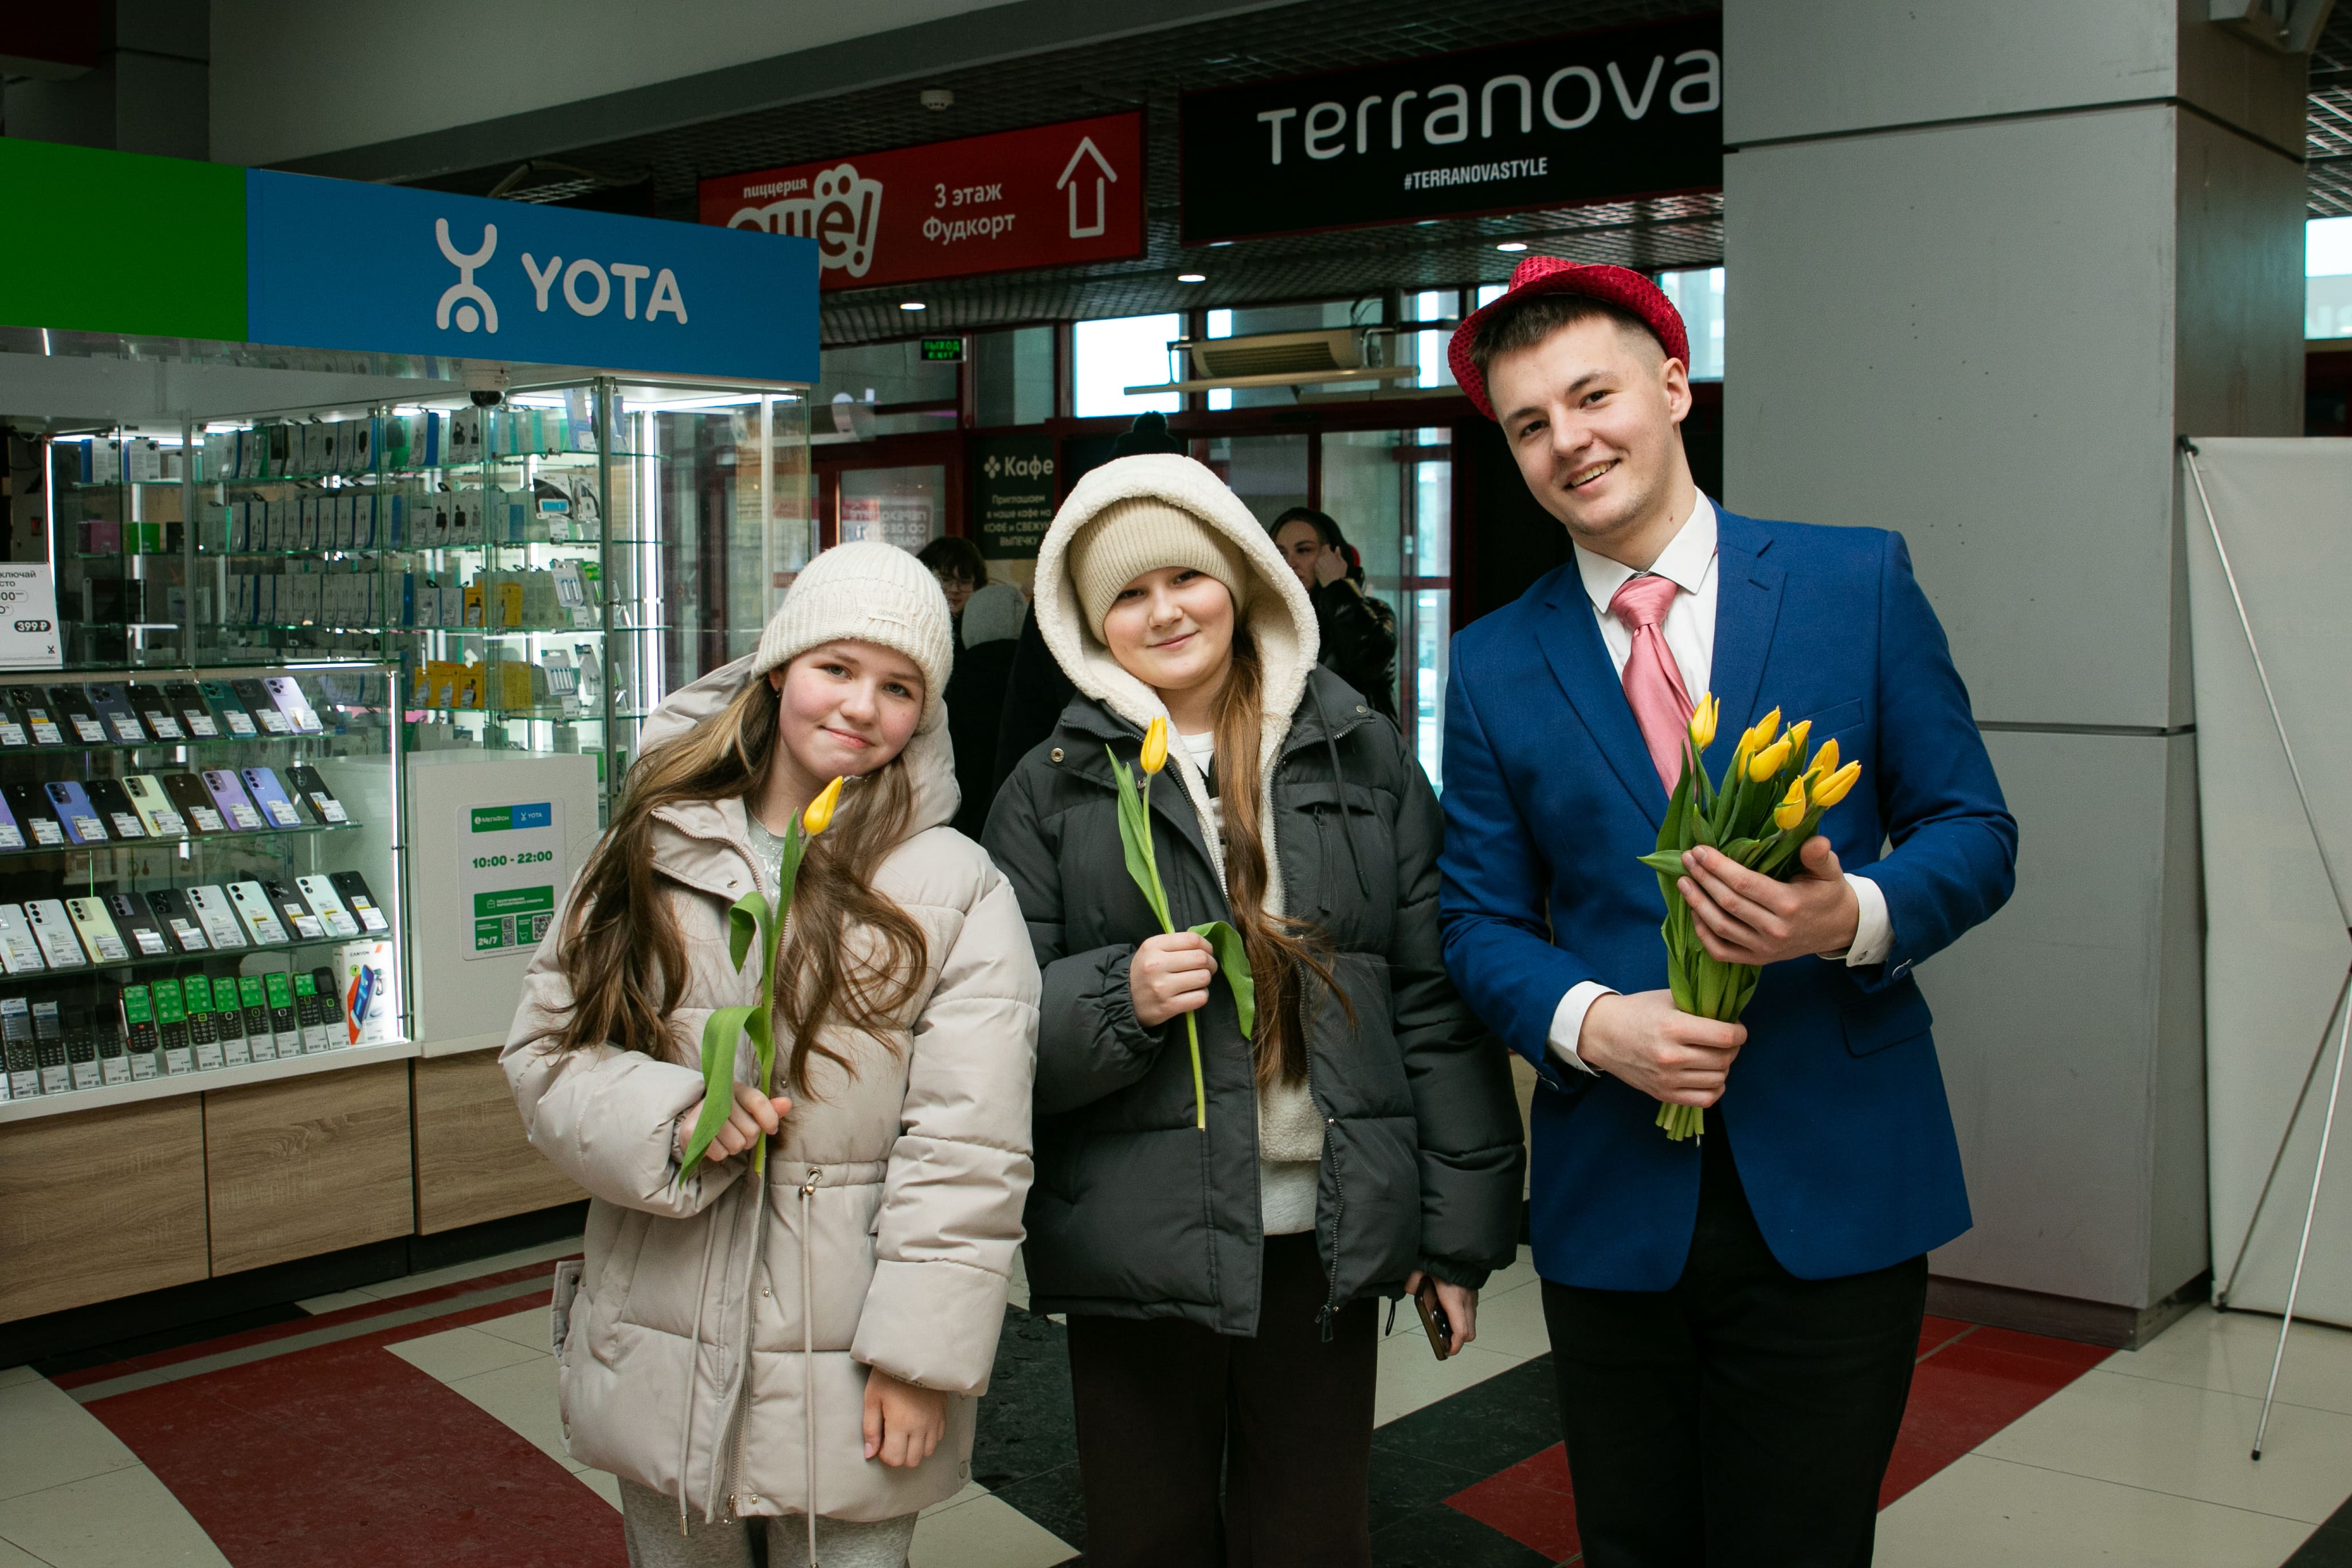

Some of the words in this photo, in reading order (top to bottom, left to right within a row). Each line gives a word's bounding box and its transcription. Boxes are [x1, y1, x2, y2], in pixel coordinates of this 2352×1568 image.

[1404, 157, 1548, 191] #TERRANOVASTYLE
[743, 178, 807, 198] пиццерия
[934, 183, 946, 209] 3
[952, 183, 1002, 206] этаж
[923, 214, 1016, 245] Фудкорт
[521, 252, 688, 326] YOTA
[1004, 454, 1055, 480] Кафе
[0, 592, 15, 601] 00
[472, 855, 507, 868] 10:00
[517, 850, 553, 864] 22:00
[477, 936, 498, 946] 24/7
